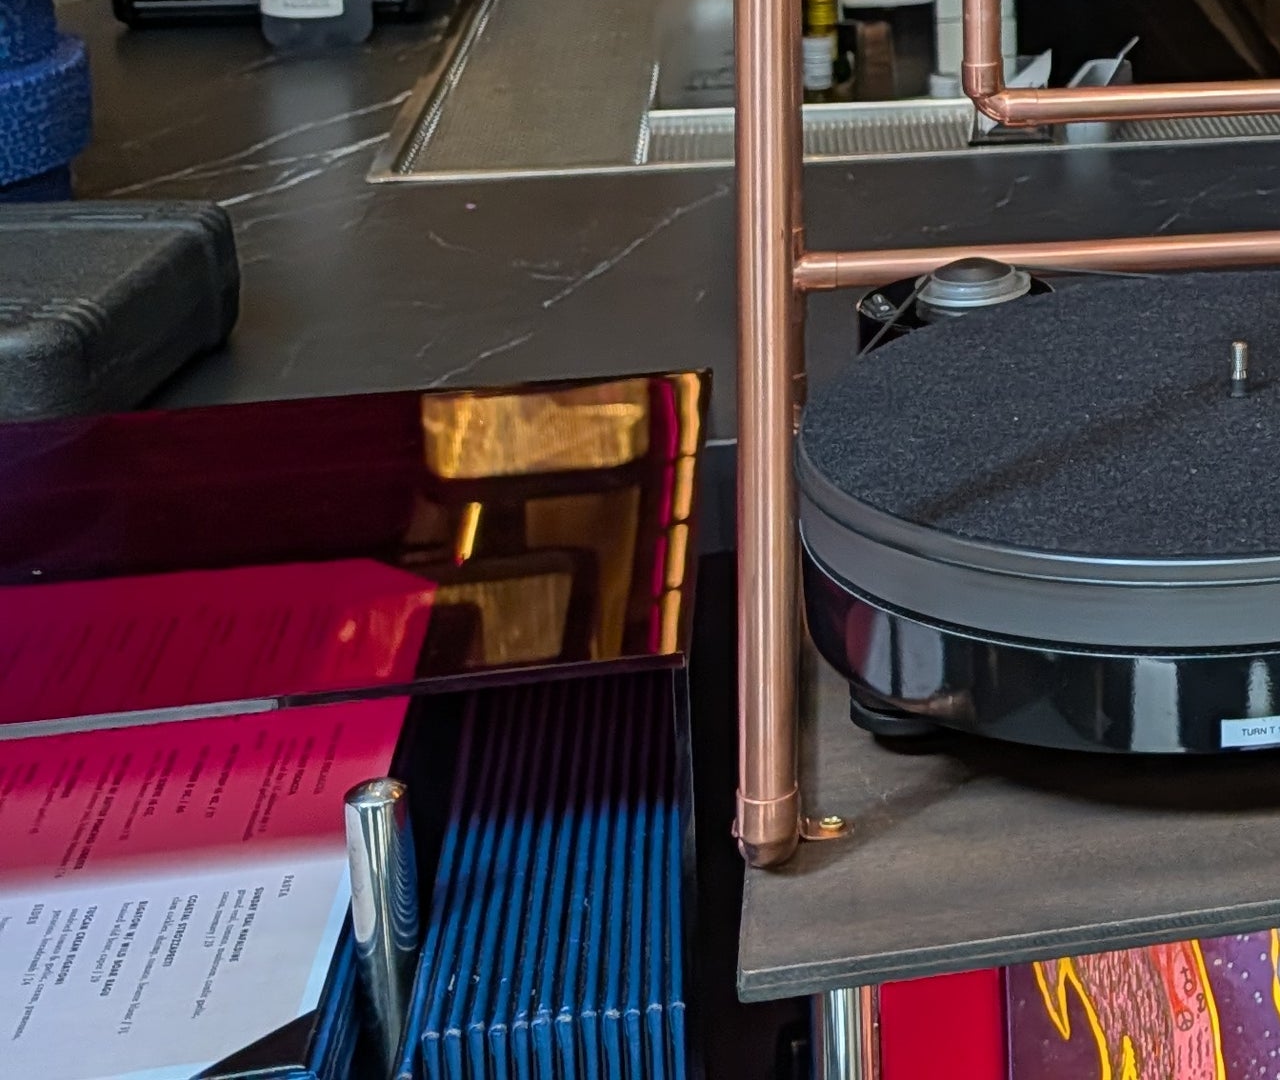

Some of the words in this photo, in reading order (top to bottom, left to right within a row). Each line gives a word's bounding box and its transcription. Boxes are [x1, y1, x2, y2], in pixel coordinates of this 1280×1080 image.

[1241, 727, 1268, 737] TURN
[277, 874, 294, 897] PASTA
[78, 905, 98, 930] TUSCAN
[127, 900, 149, 930] RIGATONI
[180, 894, 199, 920] COASTAL
[242, 912, 255, 926] VEAL
[68, 930, 87, 952] CREAM
[115, 941, 131, 958] WILD
[54, 953, 76, 985] RIGATONI
[107, 959, 123, 977] BOAR
[99, 978, 115, 996] RAGU
